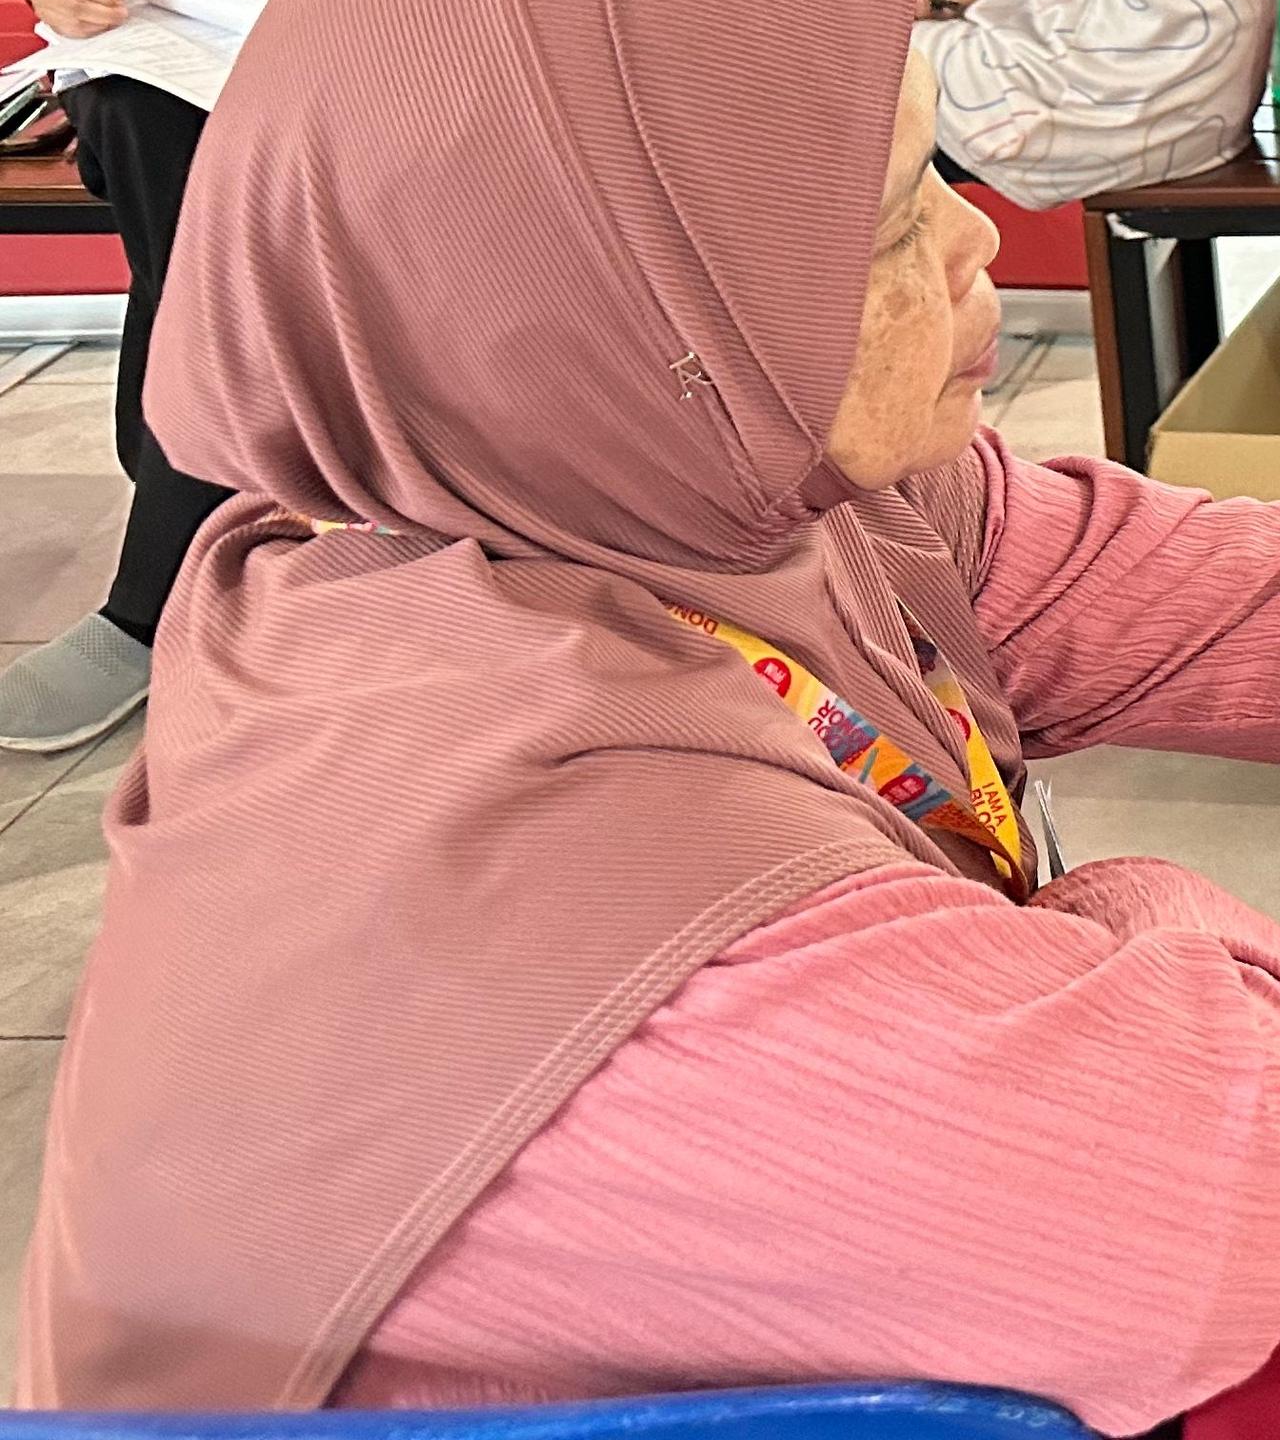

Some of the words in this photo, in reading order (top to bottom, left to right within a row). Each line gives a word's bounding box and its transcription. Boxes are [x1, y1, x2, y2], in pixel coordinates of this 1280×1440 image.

[982, 781, 995, 789] I
[984, 791, 1004, 813] AM
[994, 814, 1007, 827] A
